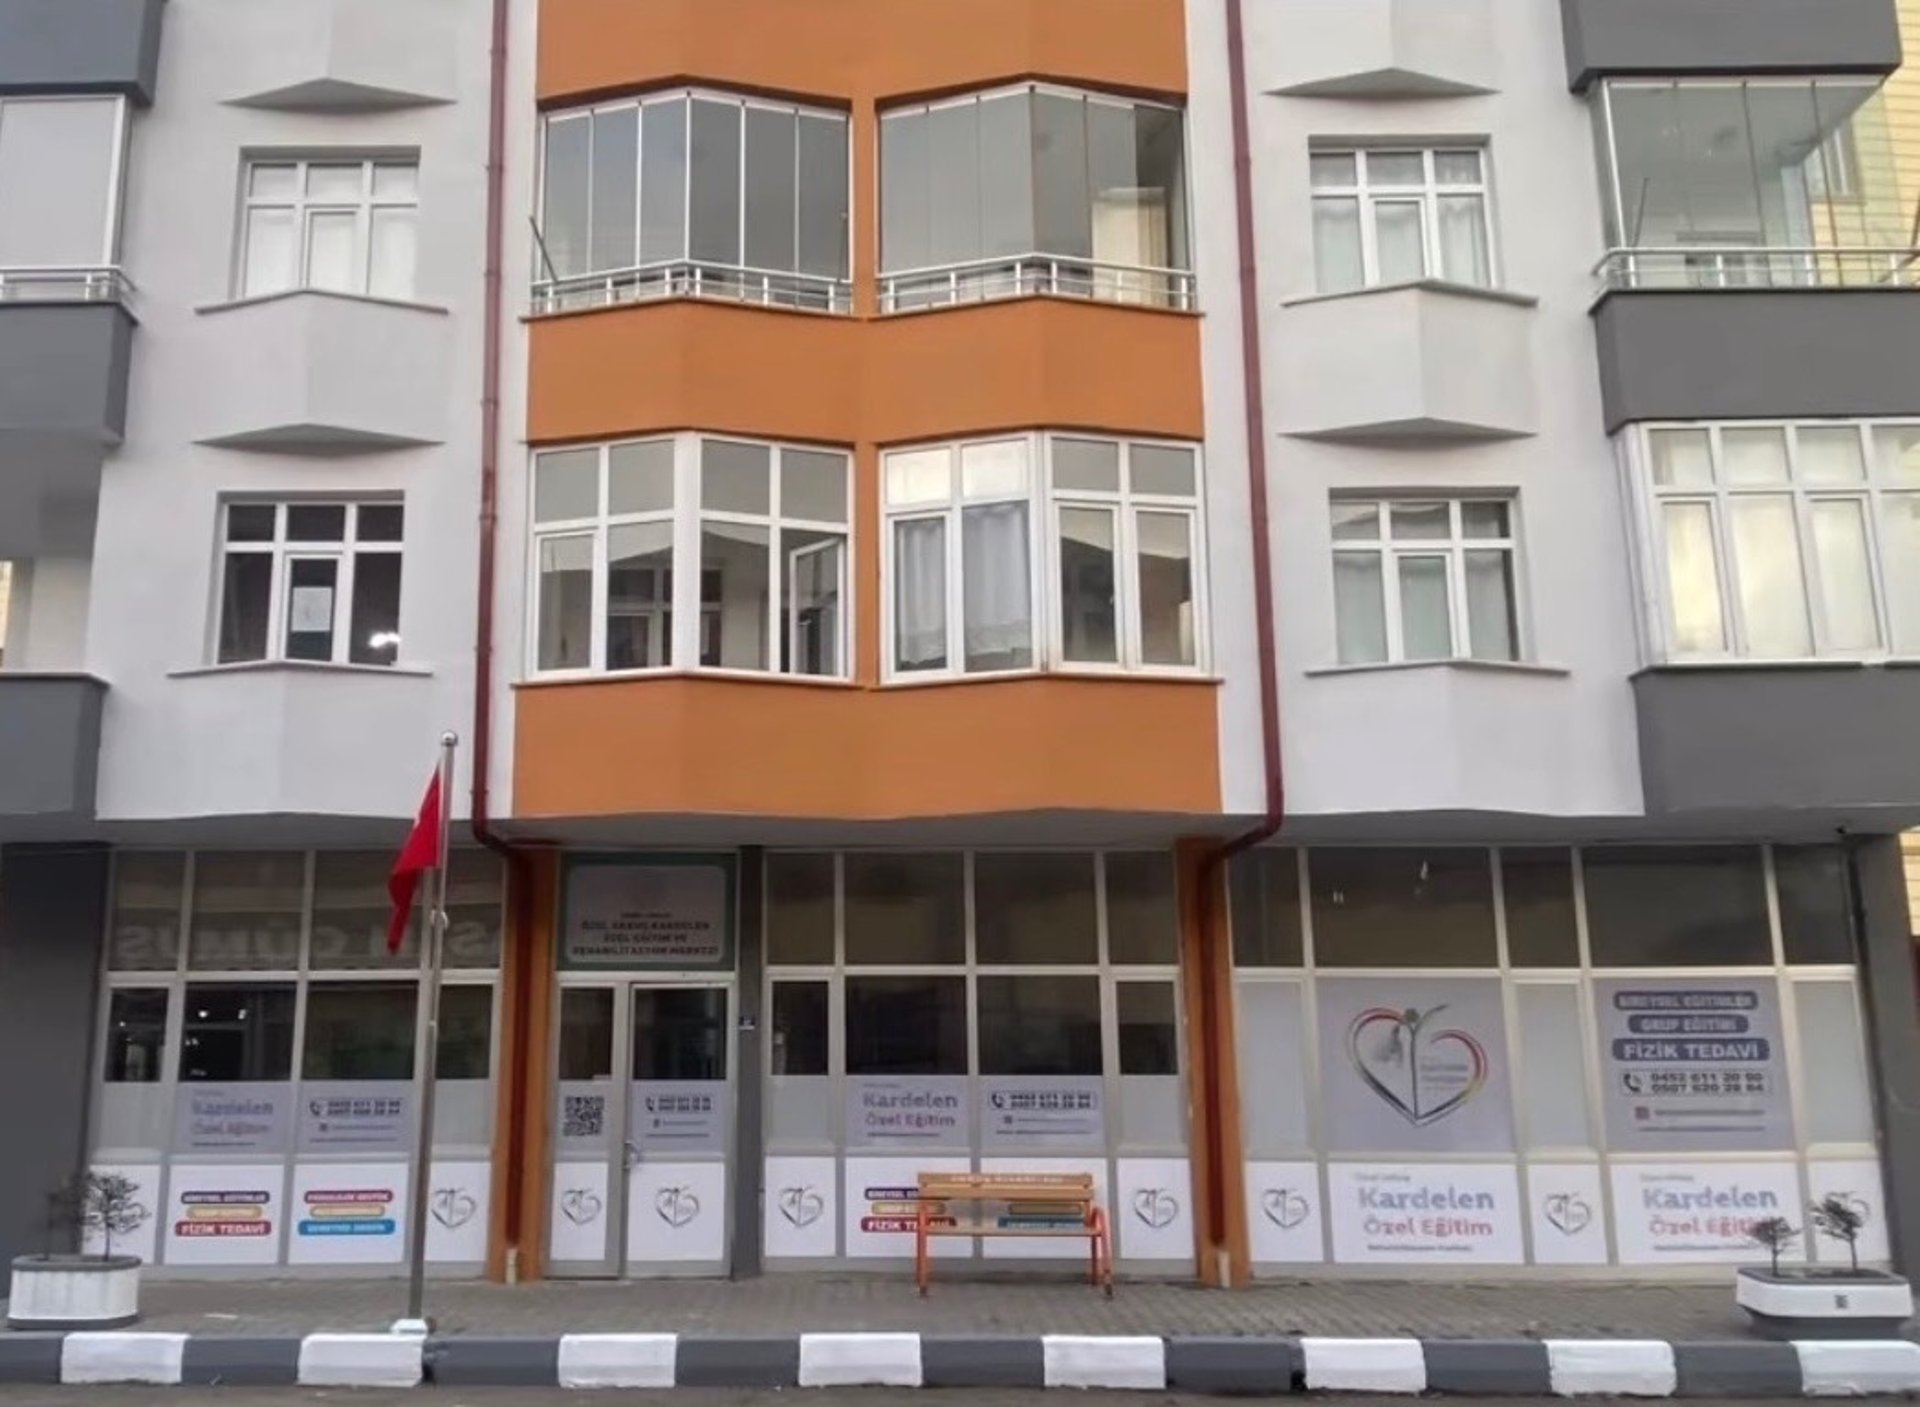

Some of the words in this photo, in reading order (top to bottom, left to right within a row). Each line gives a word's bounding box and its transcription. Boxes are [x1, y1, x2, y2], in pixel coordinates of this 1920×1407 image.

[1623, 1040, 1680, 1059] FİZİK
[1683, 1041, 1759, 1059] TEDAVİ
[863, 1092, 958, 1108] Kardelen
[864, 1111, 902, 1126] Özel
[905, 1112, 956, 1128] Eğitim
[1357, 1186, 1495, 1210] Kardelen
[1642, 1185, 1778, 1210] Kardelen
[181, 1222, 215, 1233] FİZİK
[219, 1222, 265, 1233] TEDAVİ
[1363, 1214, 1415, 1235] Özel
[1420, 1216, 1493, 1237] Eğitim
[1648, 1214, 1702, 1236] Özel
[1706, 1215, 1776, 1237] Eğit
